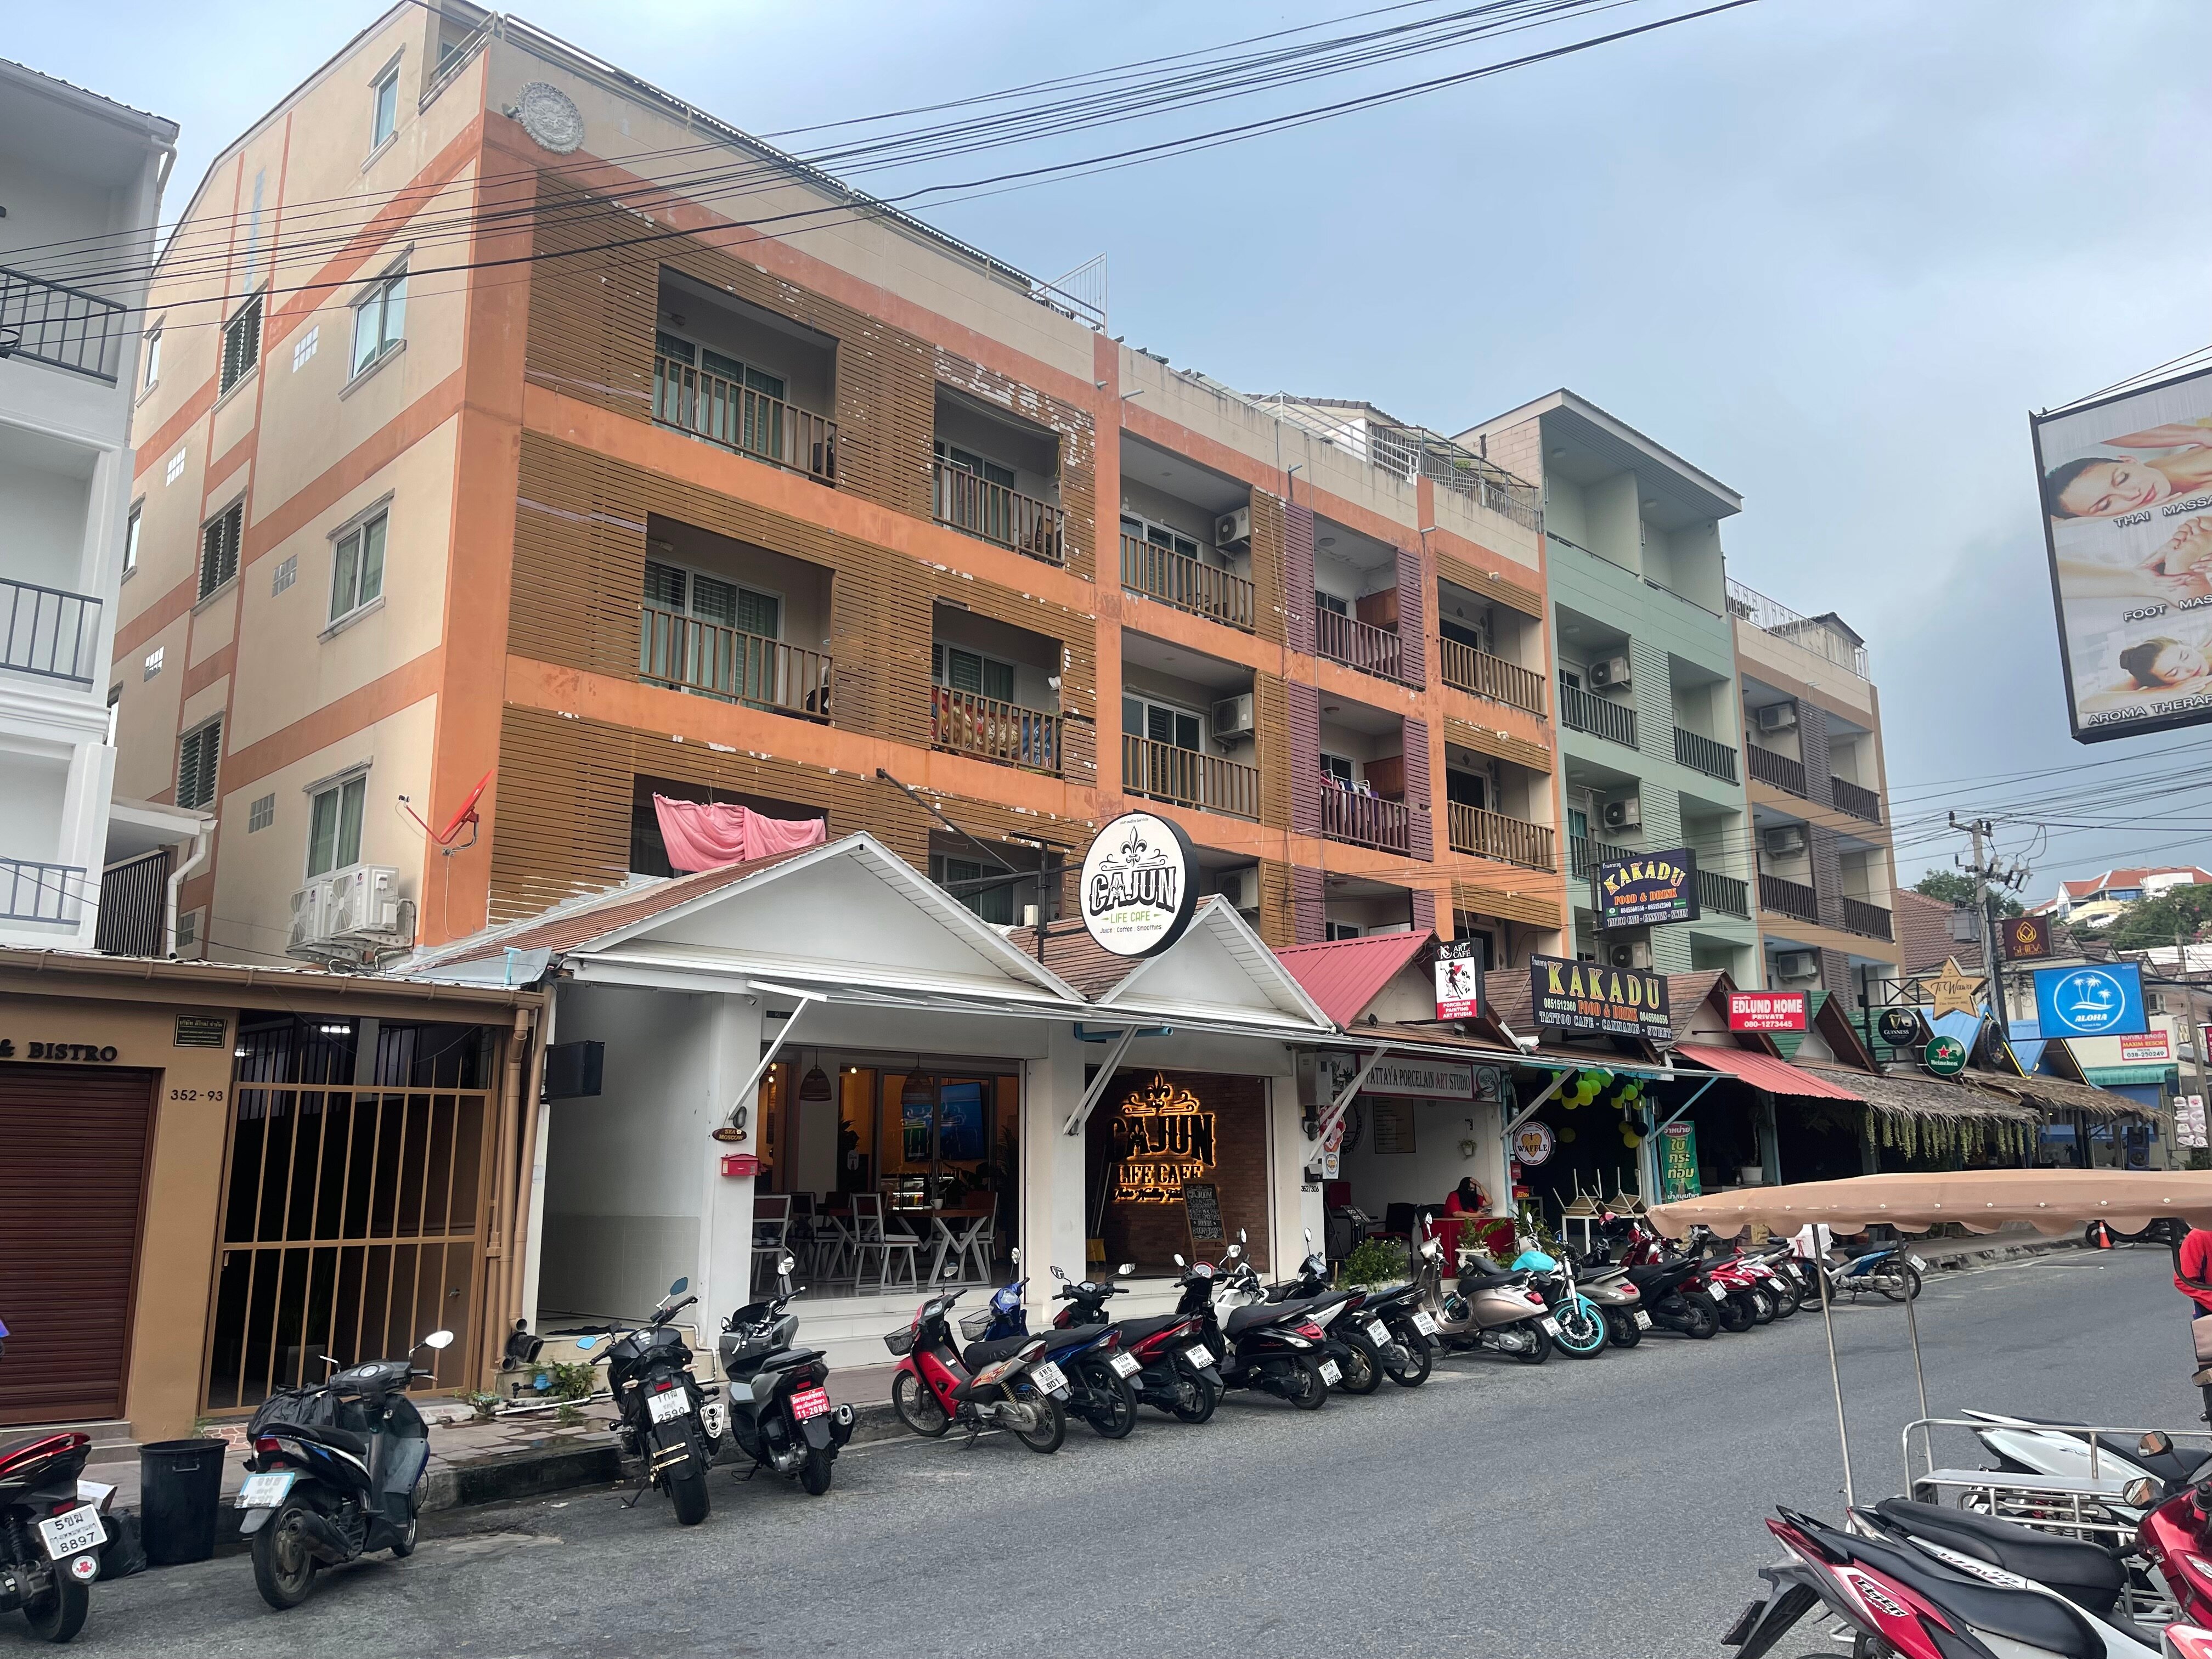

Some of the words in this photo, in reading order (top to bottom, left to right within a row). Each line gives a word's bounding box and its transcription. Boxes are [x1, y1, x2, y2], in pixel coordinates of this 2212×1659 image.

[2114, 511, 2149, 526] THAI
[2124, 605, 2166, 620] FOOT
[2089, 707, 2146, 725] AROMA
[1604, 861, 1686, 895] KAKADU
[1090, 866, 1176, 916] CAJUN
[1615, 894, 1637, 905] FOOD
[1640, 892, 1647, 902] &
[1650, 888, 1677, 901] DRINK
[1110, 912, 1128, 923] LIFE
[1131, 909, 1150, 922] CAFÉ
[1607, 918, 1627, 927] TATTOO
[1627, 915, 1639, 924] CAFE
[1643, 912, 1667, 923] CANNABIS
[1671, 909, 1688, 919] SWEET
[1454, 944, 1467, 952] ART
[1548, 961, 1659, 1009] KAKADU
[1544, 997, 1576, 1012] 0851512360
[1578, 1000, 1601, 1016] FOOD
[1603, 1003, 1610, 1018] &
[1612, 1005, 1638, 1022] DRINK
[1640, 1012, 1668, 1025] 0845560556
[1733, 999, 1771, 1014] EDLUND
[1774, 998, 1803, 1013] HOME
[1539, 1011, 1571, 1025] TATTOO
[1573, 1015, 1594, 1029] CAFE
[1601, 1019, 1640, 1035] CANNABIS
[1647, 1025, 1672, 1039] SWEET
[2075, 1013, 2107, 1022] ALOHA
[0, 1039, 15, 1057] &
[27, 1041, 118, 1062] BISTRO
[1400, 1069, 1434, 1088] PORCELAIN
[1436, 1072, 1448, 1089] ART
[1449, 1073, 1470, 1091] STUDIO
[171, 1089, 223, 1102] 352-93
[1106, 1114, 1215, 1167] CAJUN
[1517, 1144, 1548, 1153] WAFFLE
[1671, 1138, 1686, 1151] ใบ
[1669, 1153, 1690, 1164] กระ
[1118, 1166, 1154, 1184] LIFE
[1668, 1165, 1694, 1178] ท่อม
[1046, 1379, 1060, 1390] 901
[1328, 1373, 1340, 1384] 9226
[658, 1407, 685, 1423] 2590
[797, 1403, 828, 1418] 11-2086
[60, 1532, 94, 1552] 8897
